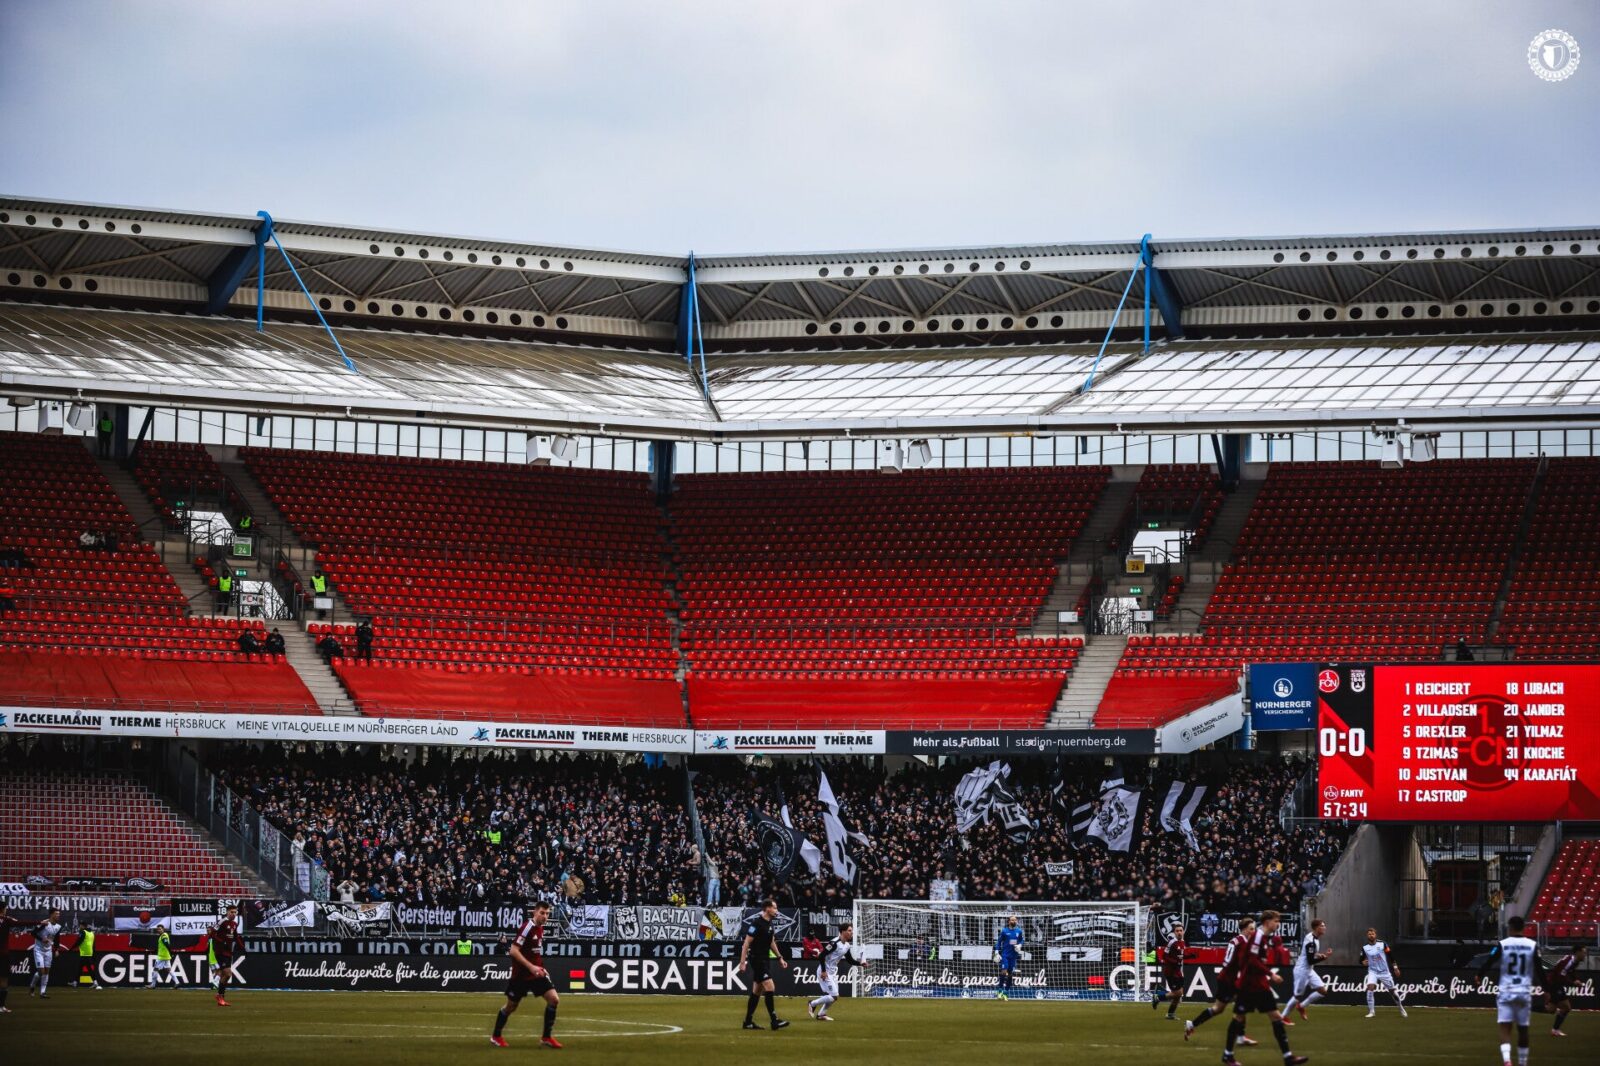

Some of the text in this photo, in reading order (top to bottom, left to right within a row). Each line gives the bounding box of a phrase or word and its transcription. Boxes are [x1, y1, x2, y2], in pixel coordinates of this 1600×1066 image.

[1405, 683, 1471, 695] 1 REICHERT
[1506, 682, 1564, 695] 18 LUBACH
[1255, 700, 1312, 709] NÜRNBERGER
[1403, 704, 1478, 716] 2 VILLADSEN
[1504, 704, 1565, 716] 20 JANDER
[14, 713, 459, 736] FACKELMANN THERME HERSBRUCK MEINE VITALQUELLE IM NÜRNBERGER LAND
[495, 728, 687, 744] FACKELMANN THERME HERSBRUCK
[1403, 726, 1466, 738] 5 DREXLER
[1506, 725, 1564, 738] 21 YILMAZ
[734, 735, 873, 745] FACKELMANN THERME
[913, 735, 1127, 748] Mehr als Fußball stadion-nuernberg.de
[1320, 728, 1365, 757] 0:0
[1403, 747, 1459, 759] 9 TZIMAS
[1506, 747, 1565, 759] 31 KNOCHE
[1399, 768, 1467, 780] 10 JUSTVAN
[1504, 765, 1577, 781] 44 KARAFIÁT
[1340, 789, 1364, 798] FANTV
[1398, 790, 1467, 802] 17 CASTROP
[1323, 802, 1368, 817] 57:34
[35, 896, 50, 910] F4
[52, 896, 70, 911] ON
[179, 904, 212, 913] ULMER
[397, 902, 524, 929] Gerstetter Touris 1846
[616, 906, 636, 917] SSV
[643, 908, 698, 925] BACHTAL
[643, 926, 697, 941] SPATZEN
[1507, 952, 1526, 977] 21
[99, 954, 247, 984] GERATK
[284, 960, 393, 986] Haushaltsgeräte
[396, 961, 417, 984] für
[420, 960, 440, 979] die
[442, 967, 477, 987] ganze
[589, 958, 748, 990] GERATEK
[912, 968, 936, 988] für
[938, 967, 960, 986] die
[963, 974, 1000, 989] ganze
[1450, 976, 1475, 999] für
[1477, 976, 1500, 995] die
